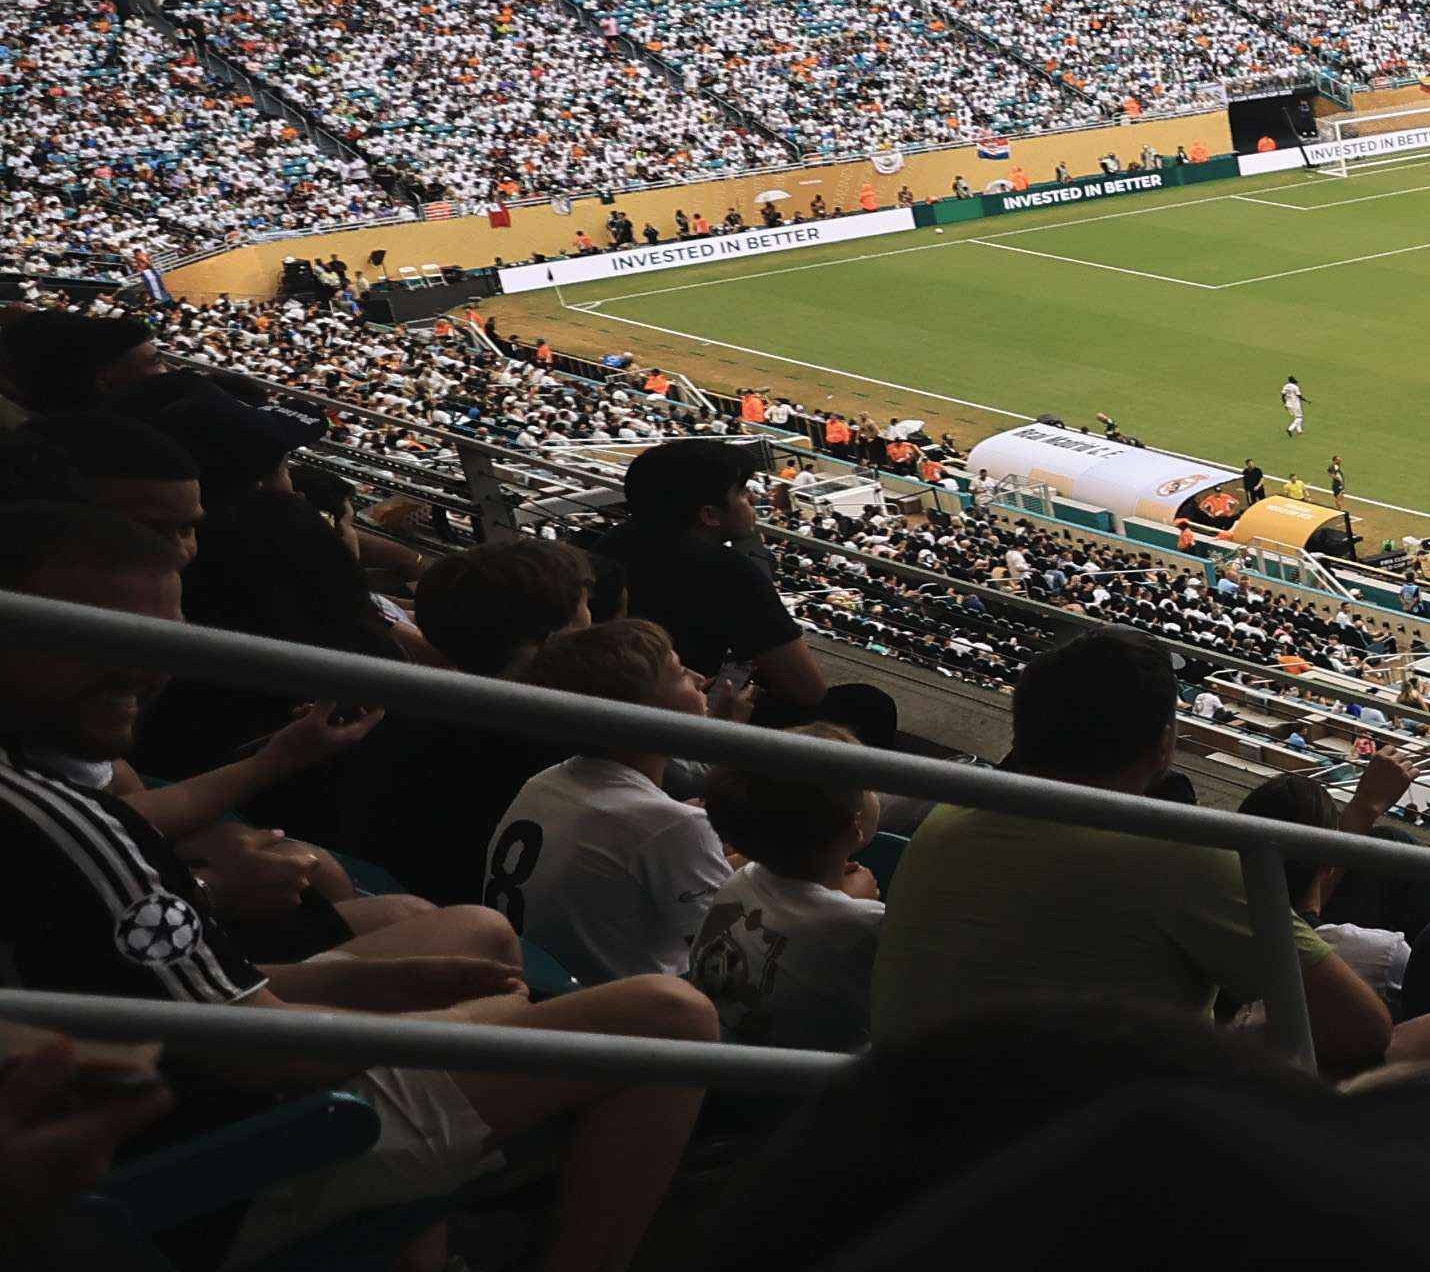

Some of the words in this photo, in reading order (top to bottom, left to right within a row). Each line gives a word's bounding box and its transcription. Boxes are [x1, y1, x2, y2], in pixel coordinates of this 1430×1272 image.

[1002, 187, 1083, 211] INVESTED
[1084, 183, 1103, 197] IN
[1103, 173, 1162, 195] BETTER
[612, 244, 716, 271] INVESTED
[719, 239, 741, 253] IN
[746, 227, 821, 250] BETTER
[484, 819, 544, 937] 8
